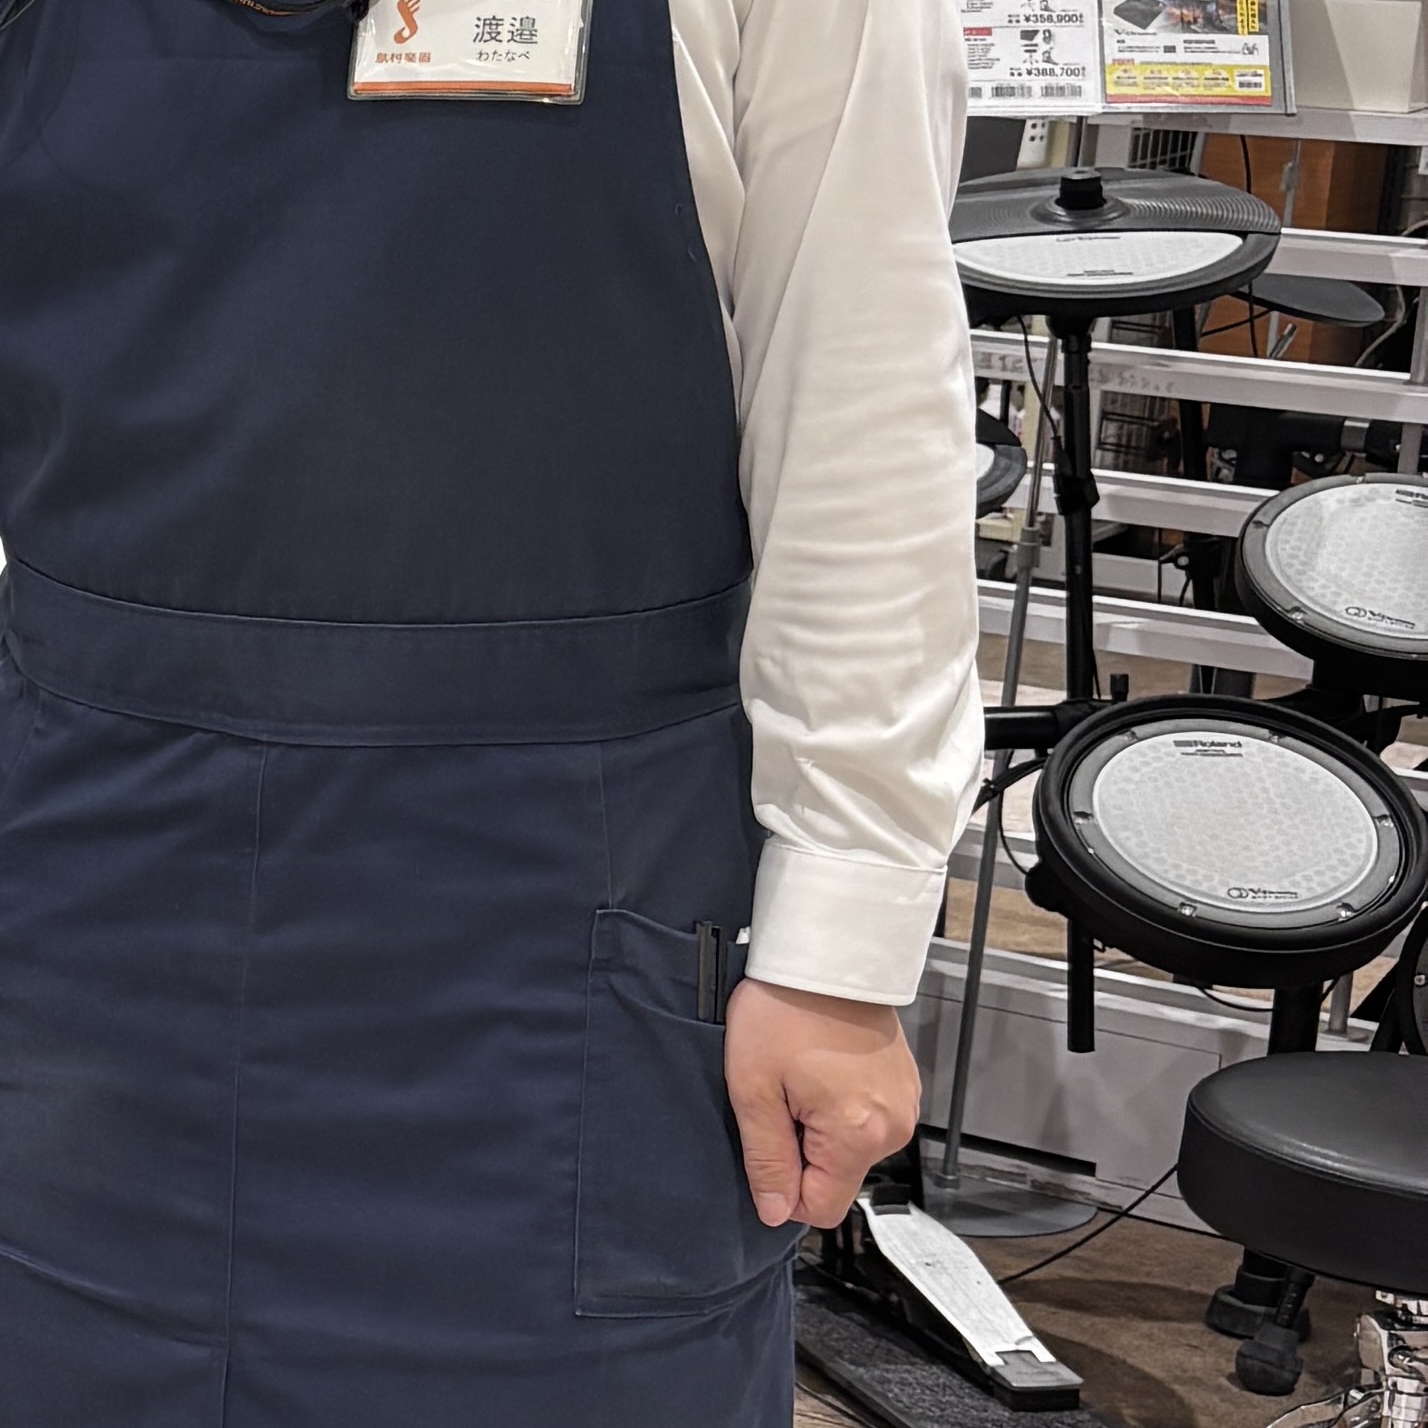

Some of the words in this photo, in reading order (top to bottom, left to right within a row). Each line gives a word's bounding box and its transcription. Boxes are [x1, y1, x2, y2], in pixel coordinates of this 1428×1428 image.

[374, 51, 431, 64] 島村楽器
[475, 48, 531, 63] わたなべ
